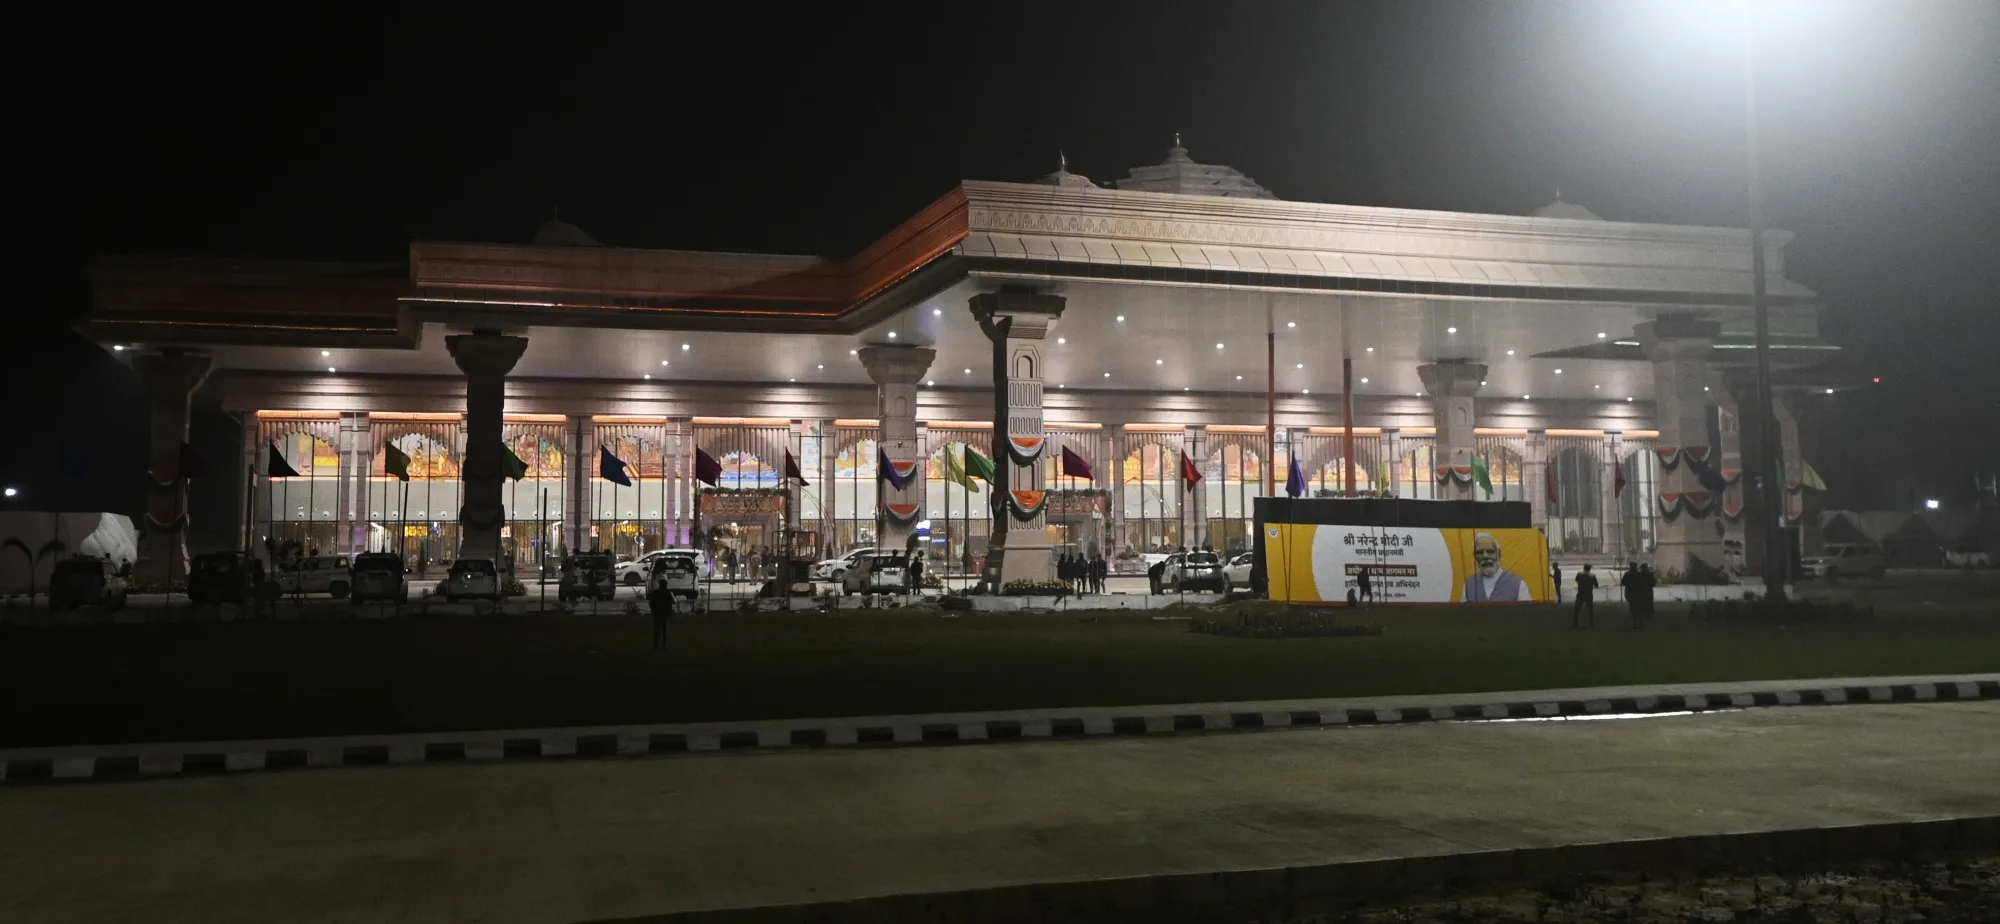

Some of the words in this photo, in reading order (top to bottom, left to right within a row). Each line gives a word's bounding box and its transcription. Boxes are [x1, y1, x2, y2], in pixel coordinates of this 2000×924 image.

[1344, 533, 1354, 545] श्री
[1357, 534, 1378, 546] नरेन्द्र
[1381, 534, 1399, 547] मोदी
[1402, 535, 1413, 546] जी
